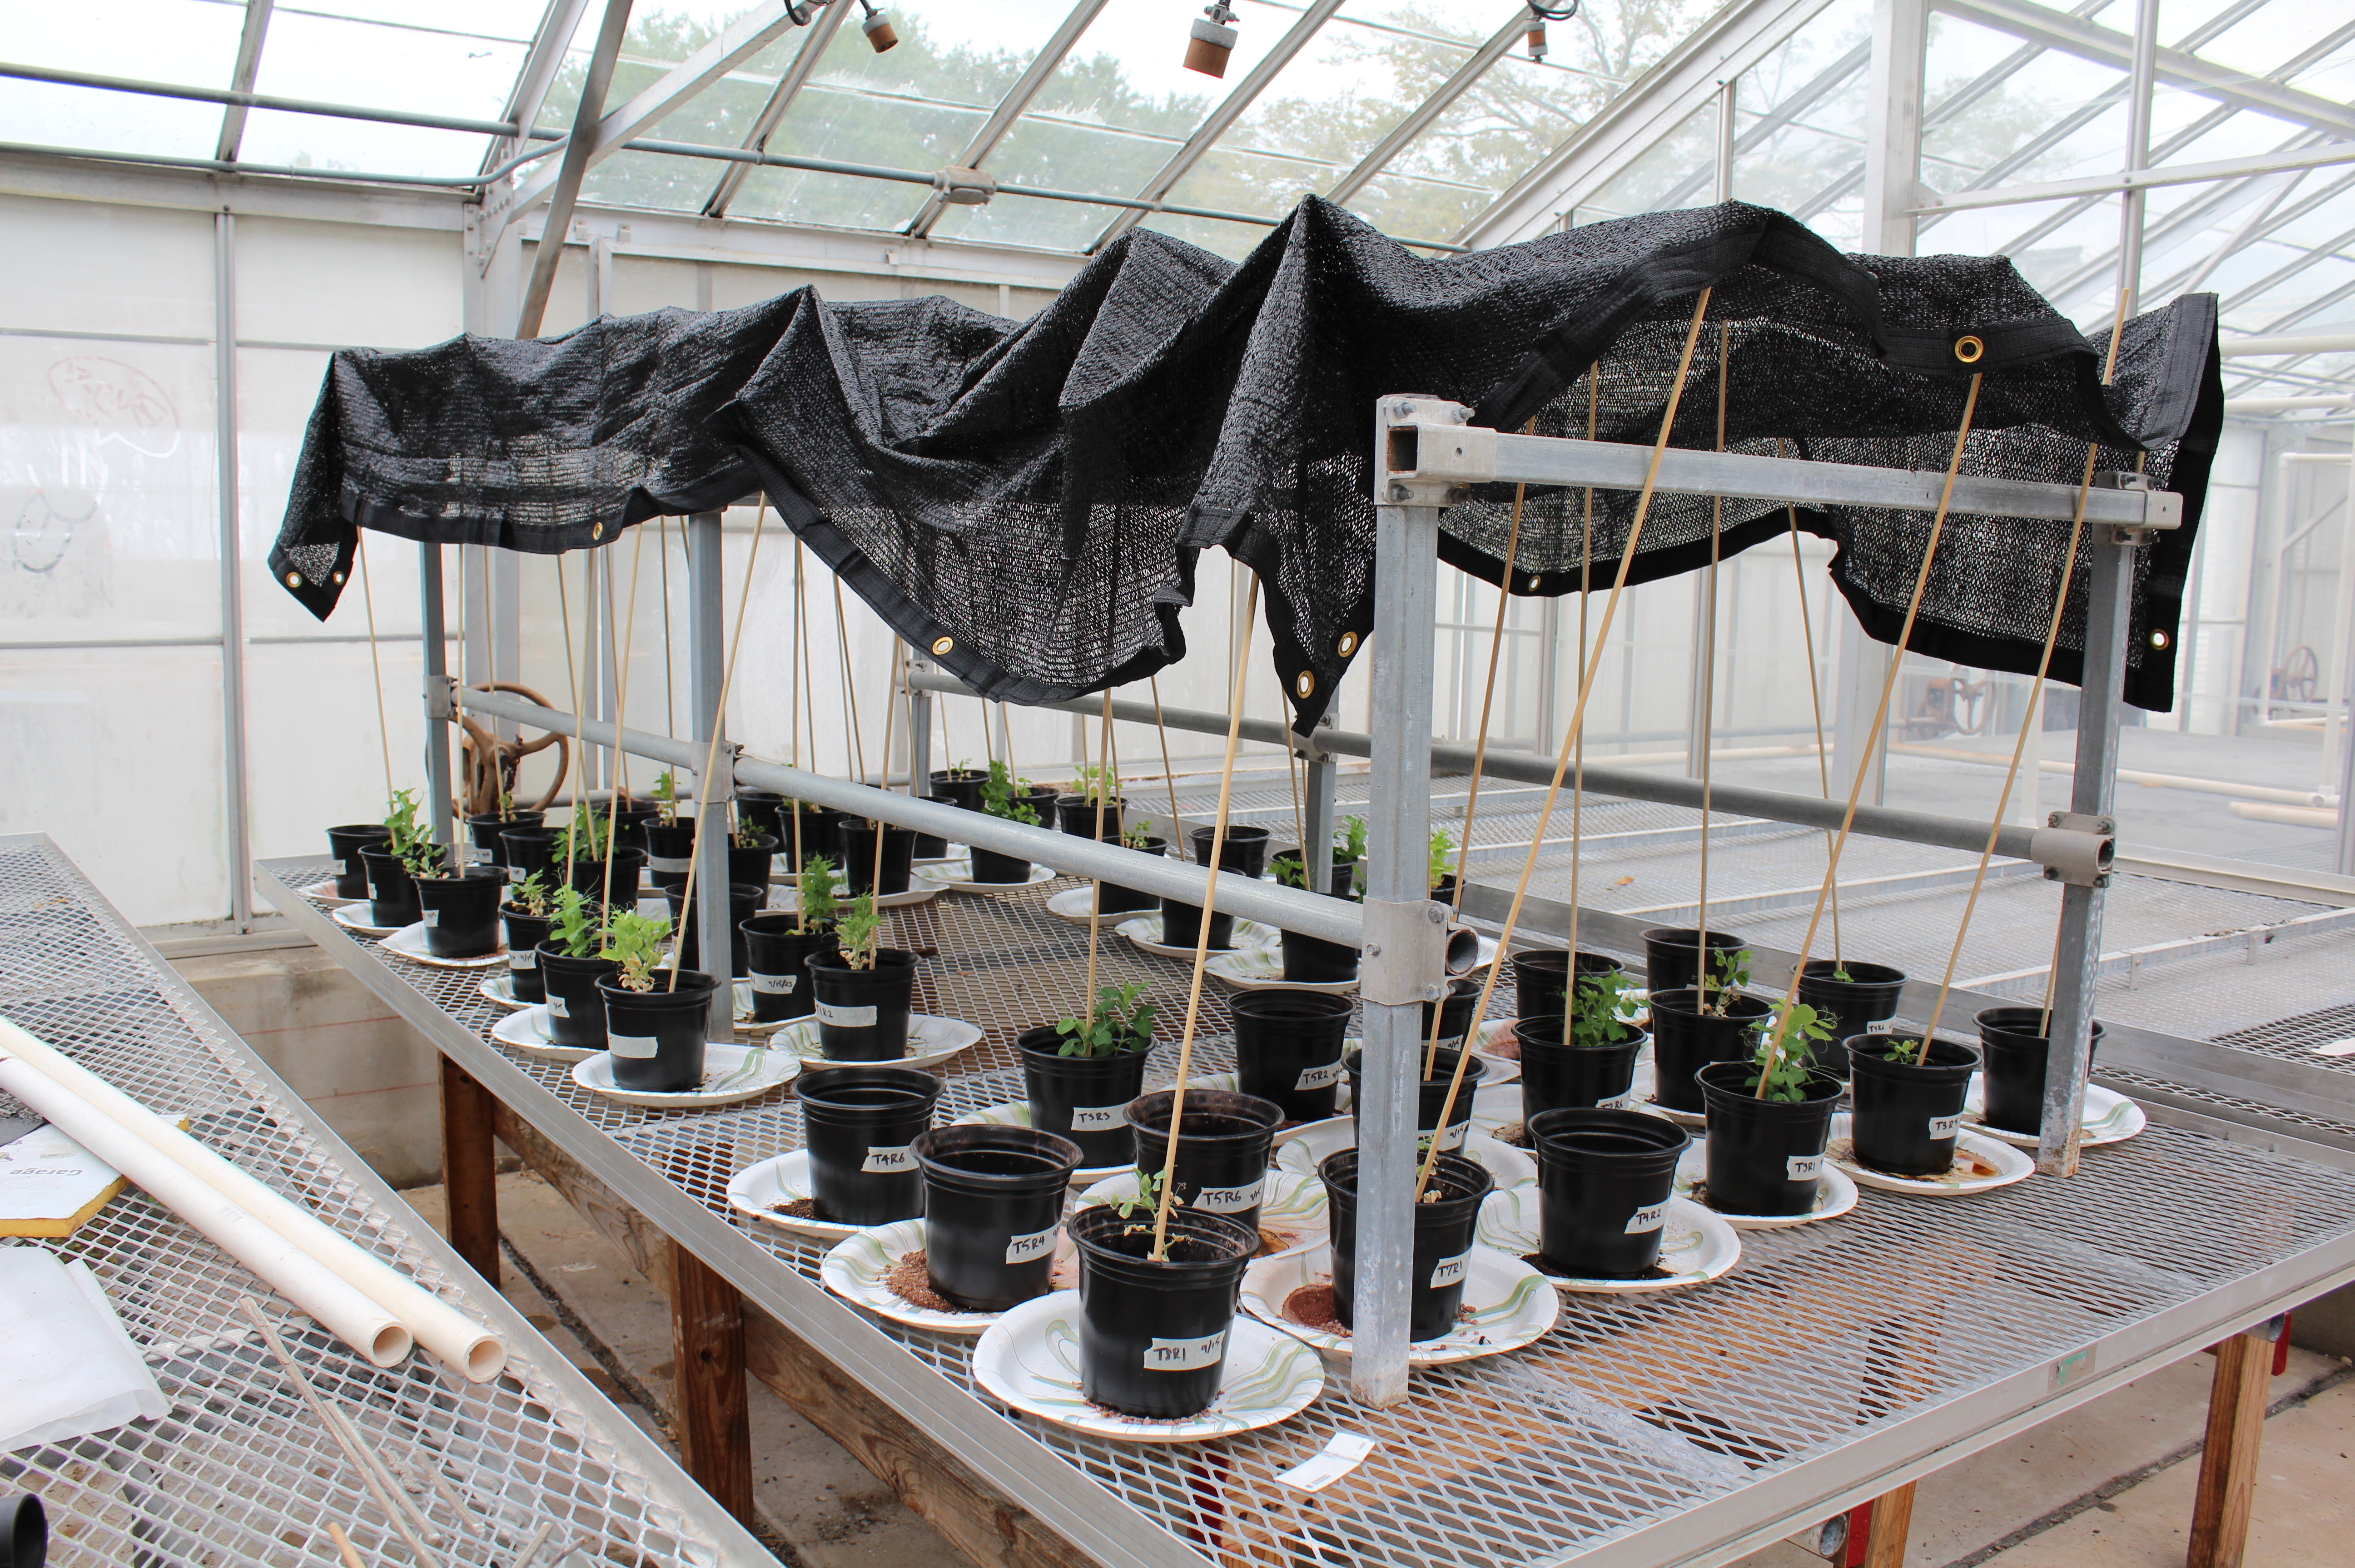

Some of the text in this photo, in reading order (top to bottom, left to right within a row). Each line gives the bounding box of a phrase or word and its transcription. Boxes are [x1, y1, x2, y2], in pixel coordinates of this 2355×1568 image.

[1303, 1071, 1329, 1084] T5R2
[871, 1152, 905, 1166] T4R6
[10, 1168, 84, 1176] Garage
[1202, 1191, 1242, 1206] T5R6
[1635, 1208, 1661, 1225] T4R2
[1013, 1235, 1045, 1255] T5R4
[1201, 1335, 1221, 1354] 9/15
